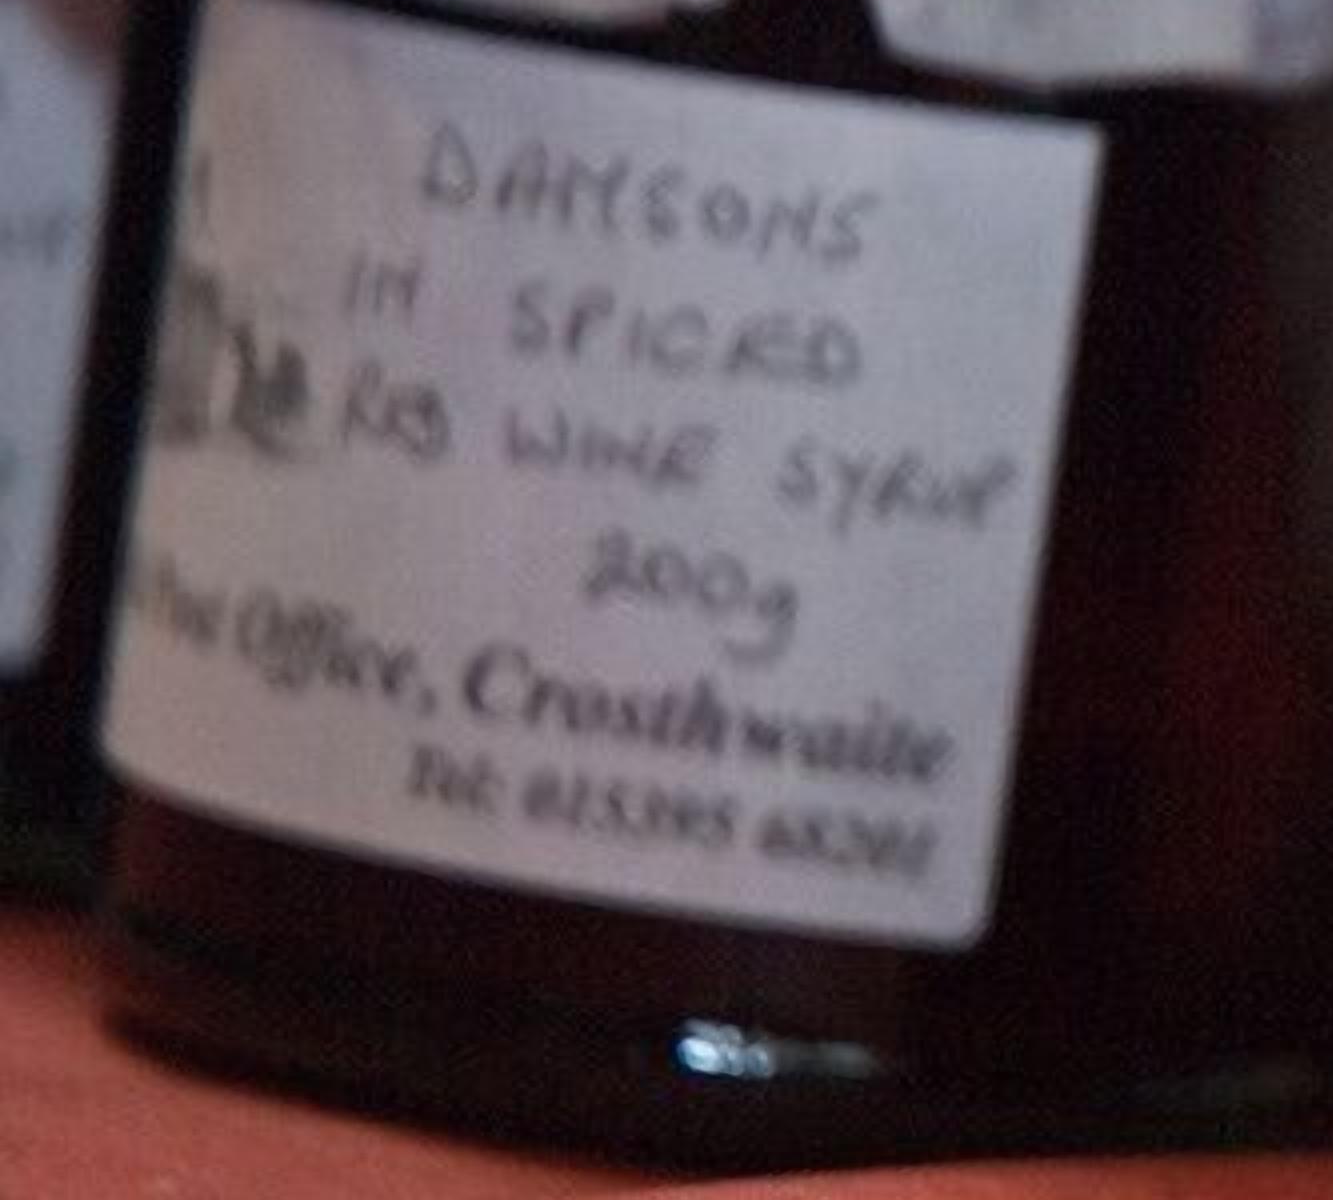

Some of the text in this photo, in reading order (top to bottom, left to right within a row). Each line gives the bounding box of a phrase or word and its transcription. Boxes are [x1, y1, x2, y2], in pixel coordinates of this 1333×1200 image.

[422, 122, 880, 263] DAMSONS
[508, 280, 862, 390] SPICED
[584, 524, 798, 665] 200g
